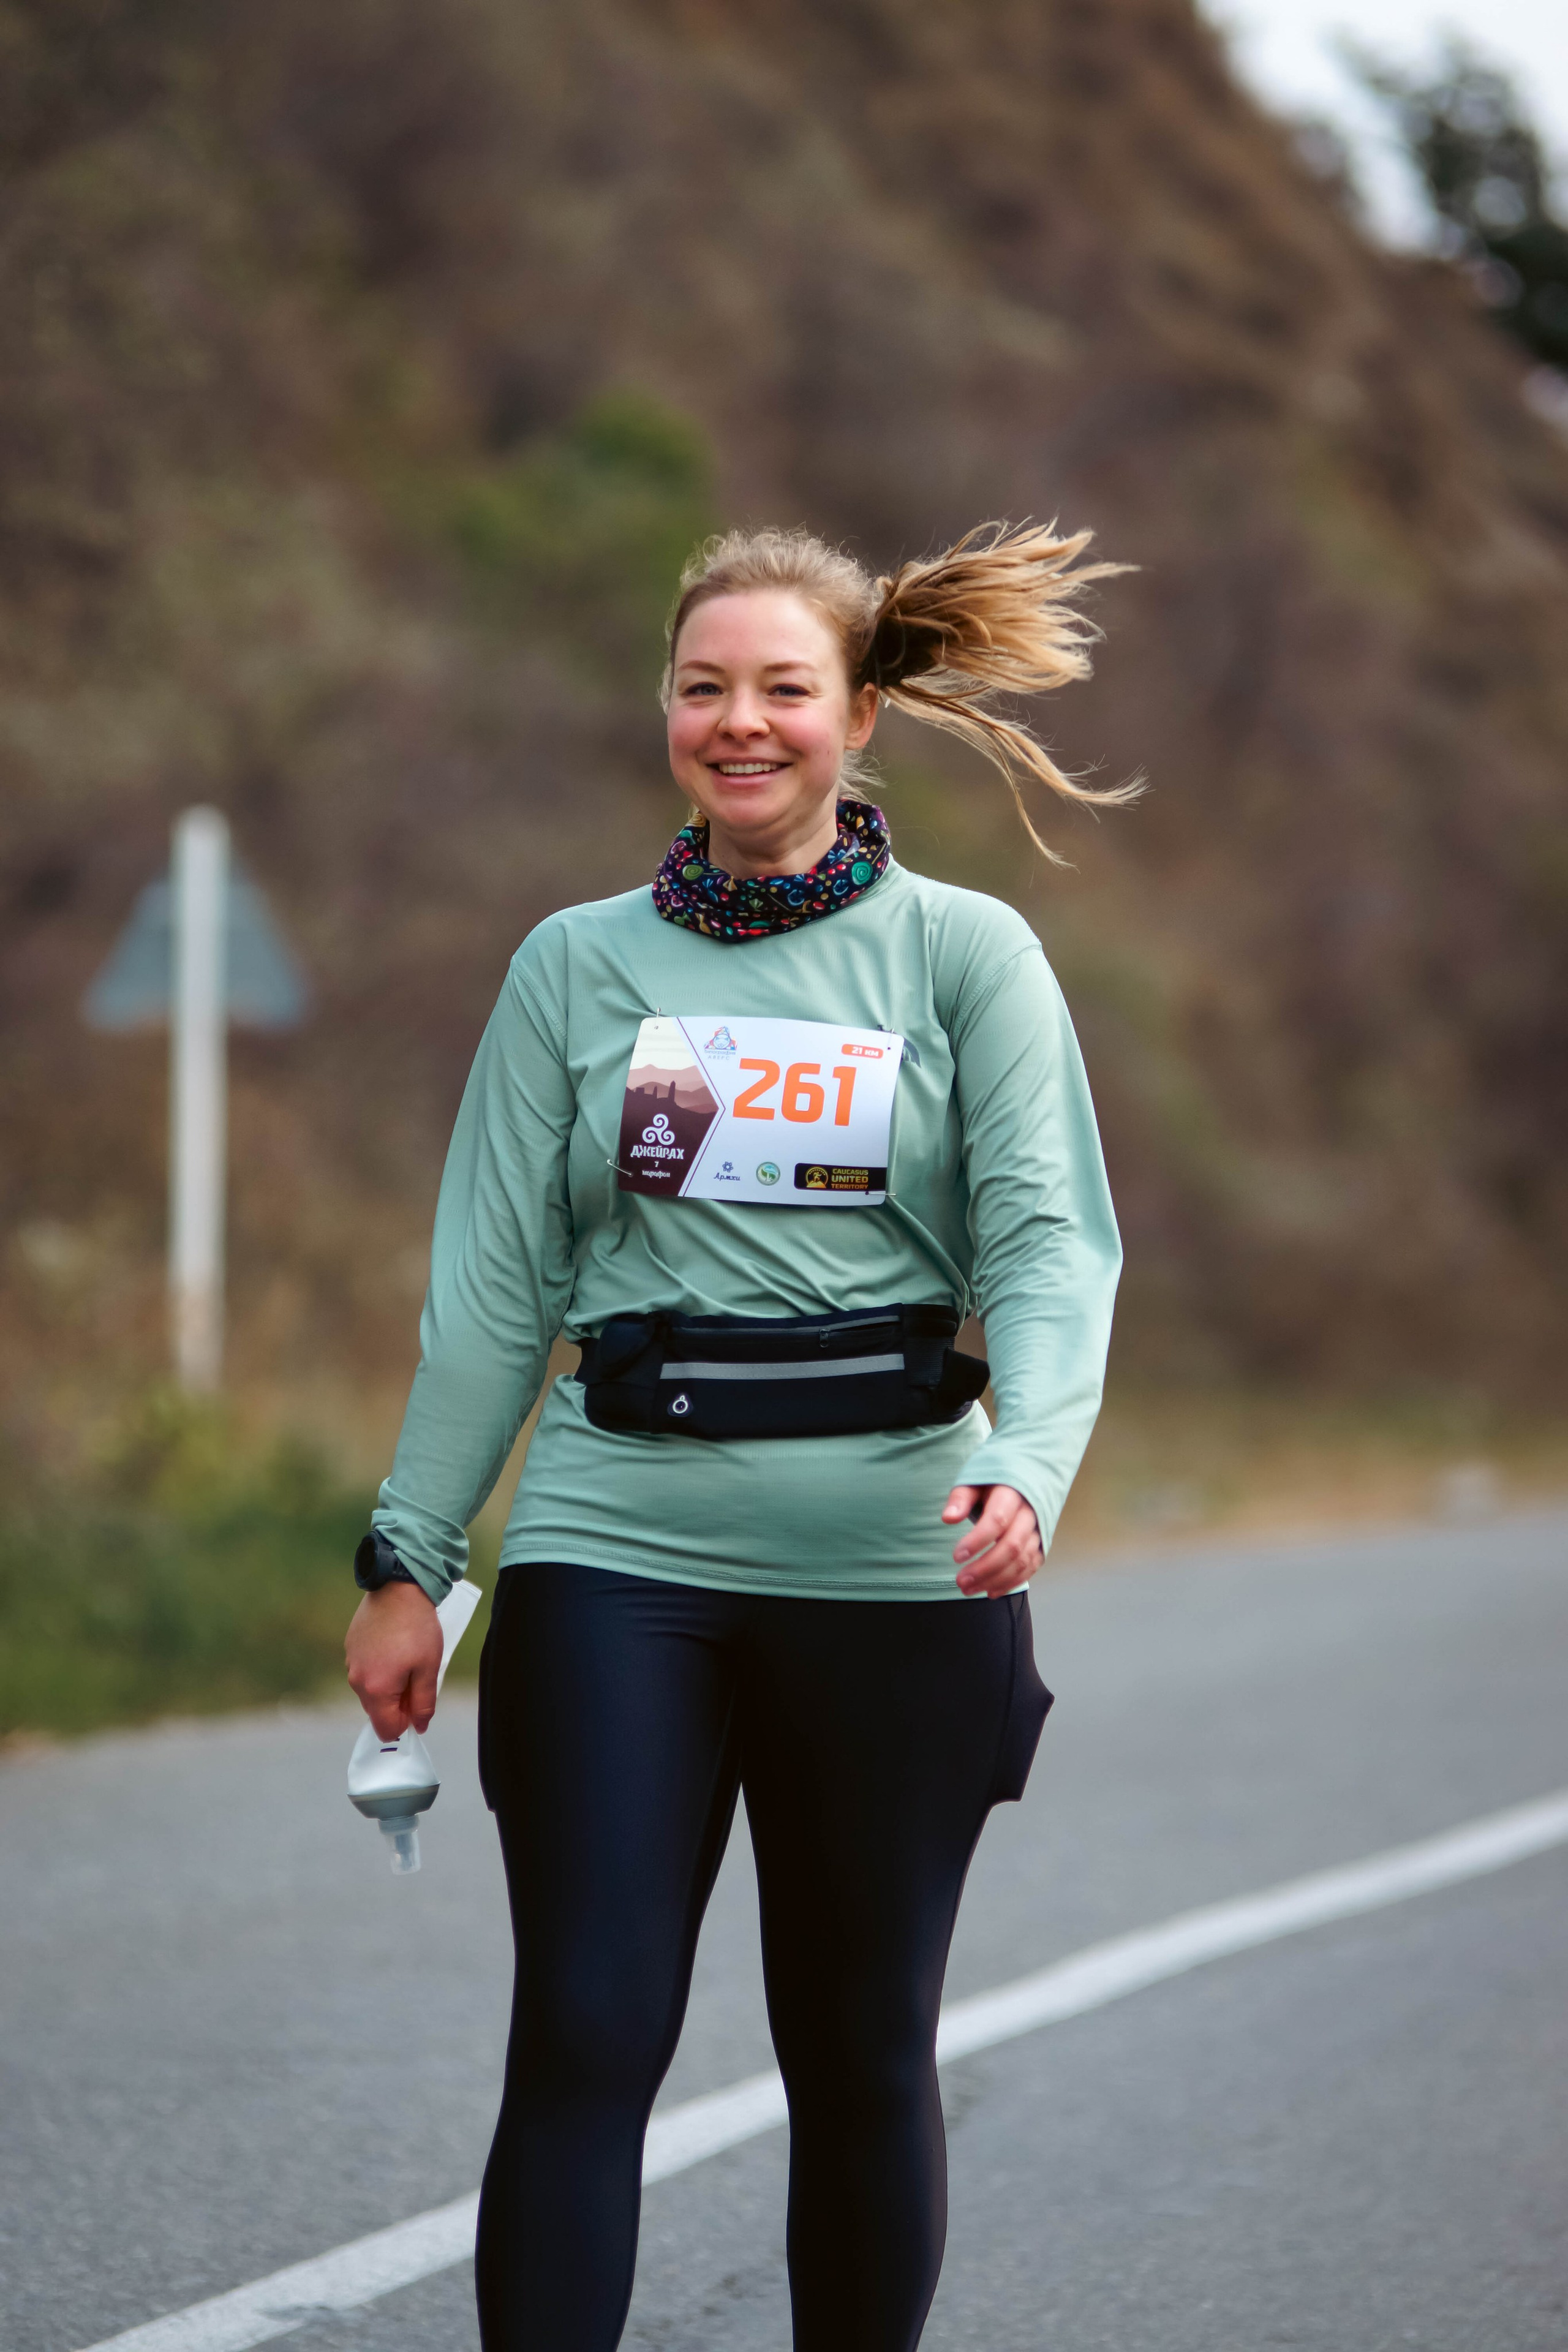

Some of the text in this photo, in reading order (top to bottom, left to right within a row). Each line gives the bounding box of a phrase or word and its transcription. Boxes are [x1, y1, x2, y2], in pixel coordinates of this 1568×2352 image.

[851, 1046, 863, 1055] 21
[733, 1058, 857, 1126] 261
[630, 1145, 685, 1159] ДЖЕЙРАХ
[642, 1170, 671, 1178] марафон
[714, 1172, 741, 1182] Армхи
